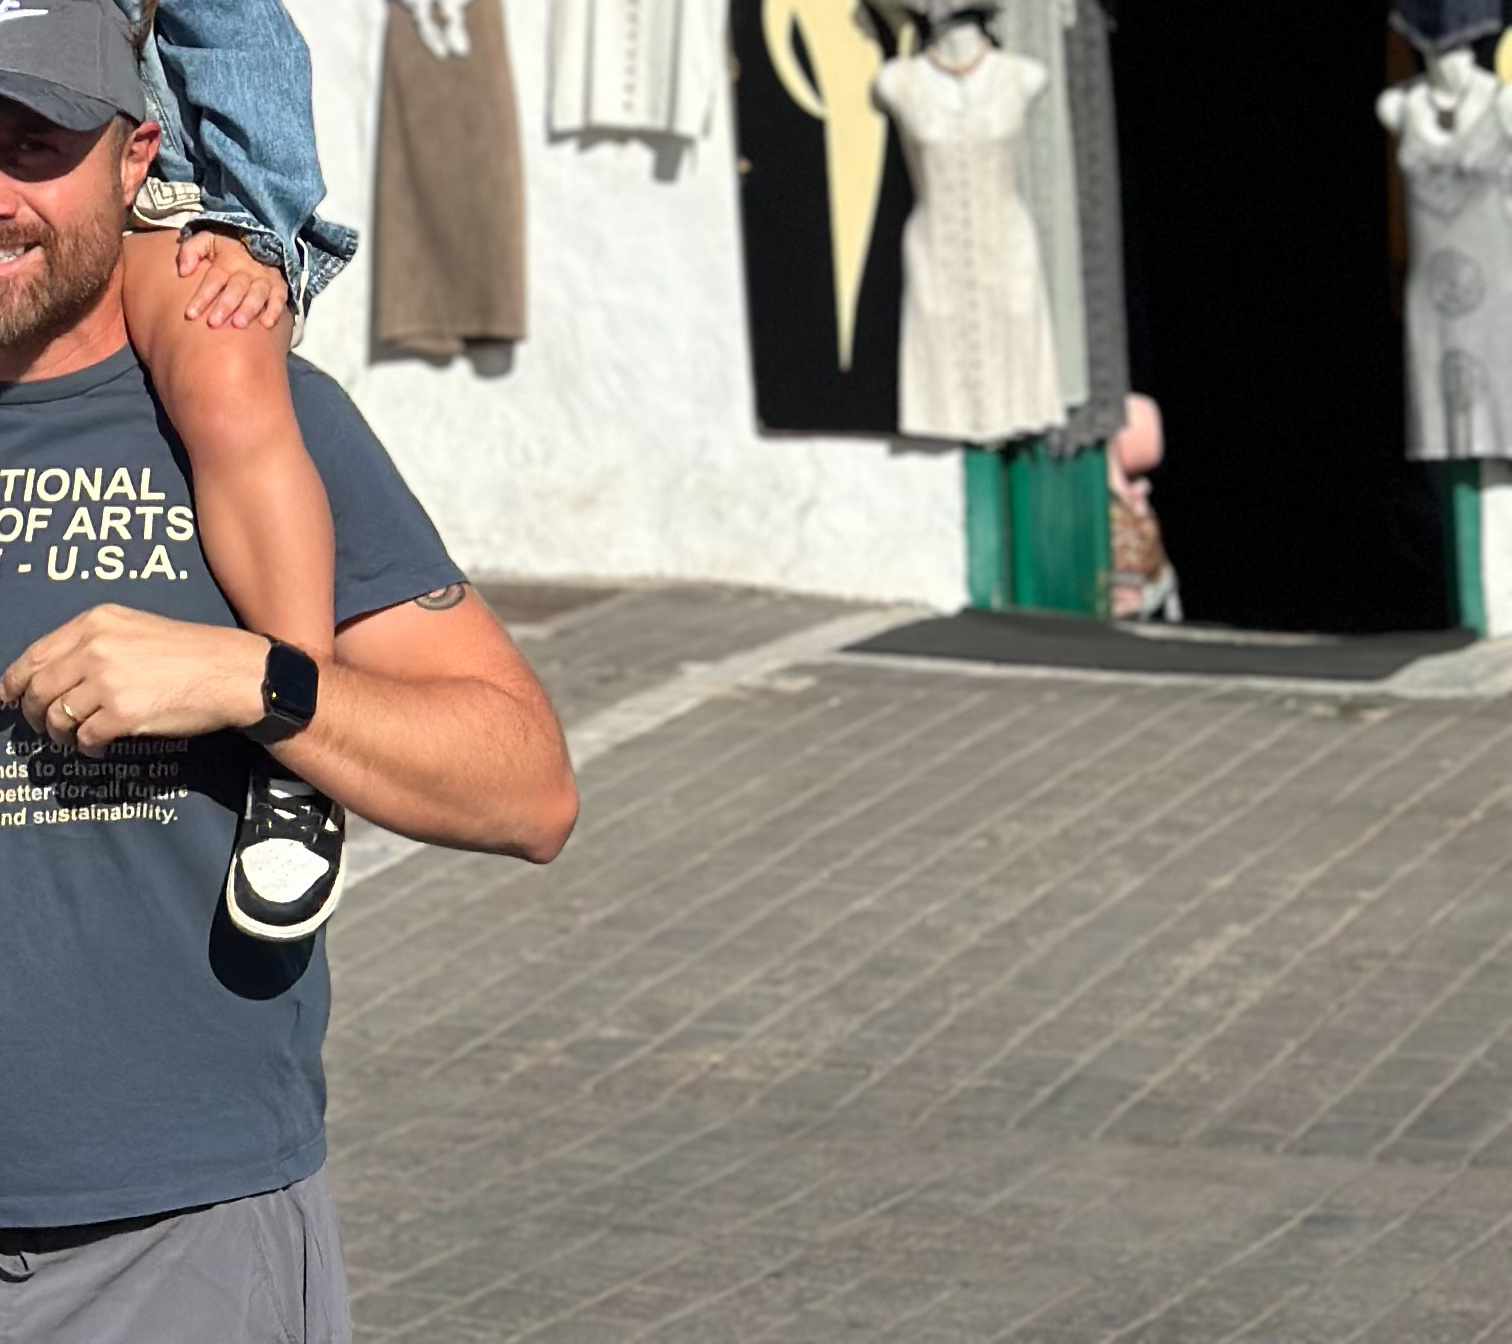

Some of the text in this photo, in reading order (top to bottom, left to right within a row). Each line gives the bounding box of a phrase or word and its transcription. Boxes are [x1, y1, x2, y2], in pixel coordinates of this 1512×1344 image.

[62, 506, 194, 542] ARTS
[47, 545, 188, 581] U.S.A.
[5, 737, 45, 756] and
[35, 761, 56, 778] to
[62, 761, 141, 782] change
[148, 761, 180, 778] the
[127, 783, 189, 802] future
[32, 801, 179, 825] sustainability.
